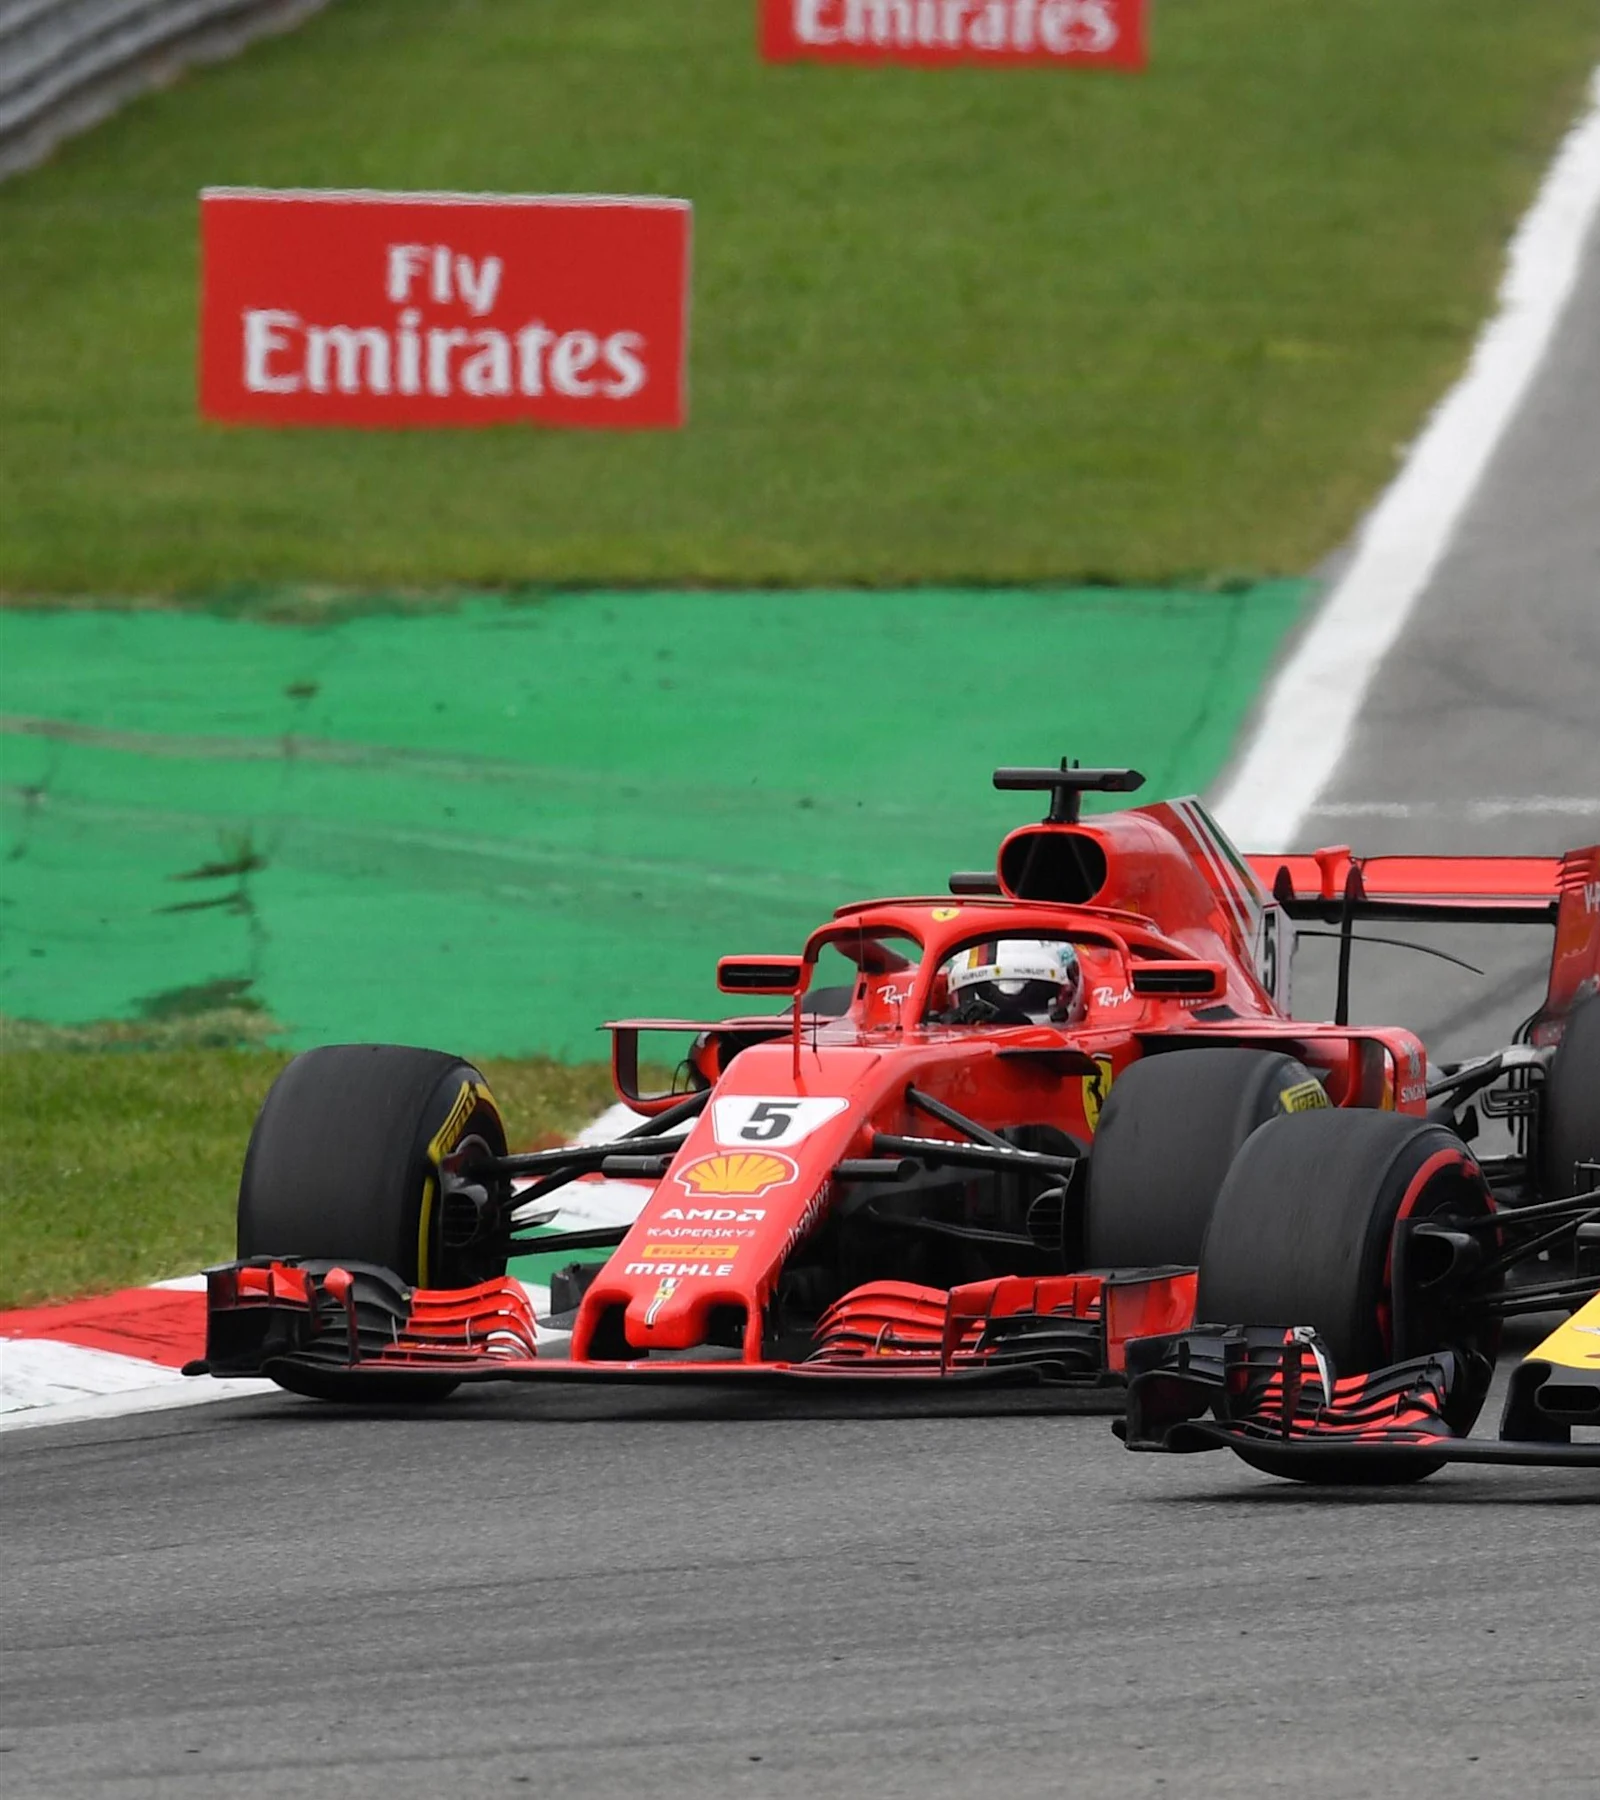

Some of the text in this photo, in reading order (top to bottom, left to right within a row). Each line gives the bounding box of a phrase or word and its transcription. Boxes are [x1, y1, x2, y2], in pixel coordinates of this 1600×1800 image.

[793, 0, 1117, 53] Emirates
[386, 244, 503, 315] Fly
[242, 306, 647, 398] Emirates
[740, 1103, 800, 1141] 5
[660, 1209, 738, 1220] AMD
[624, 1263, 733, 1276] MAHLE
